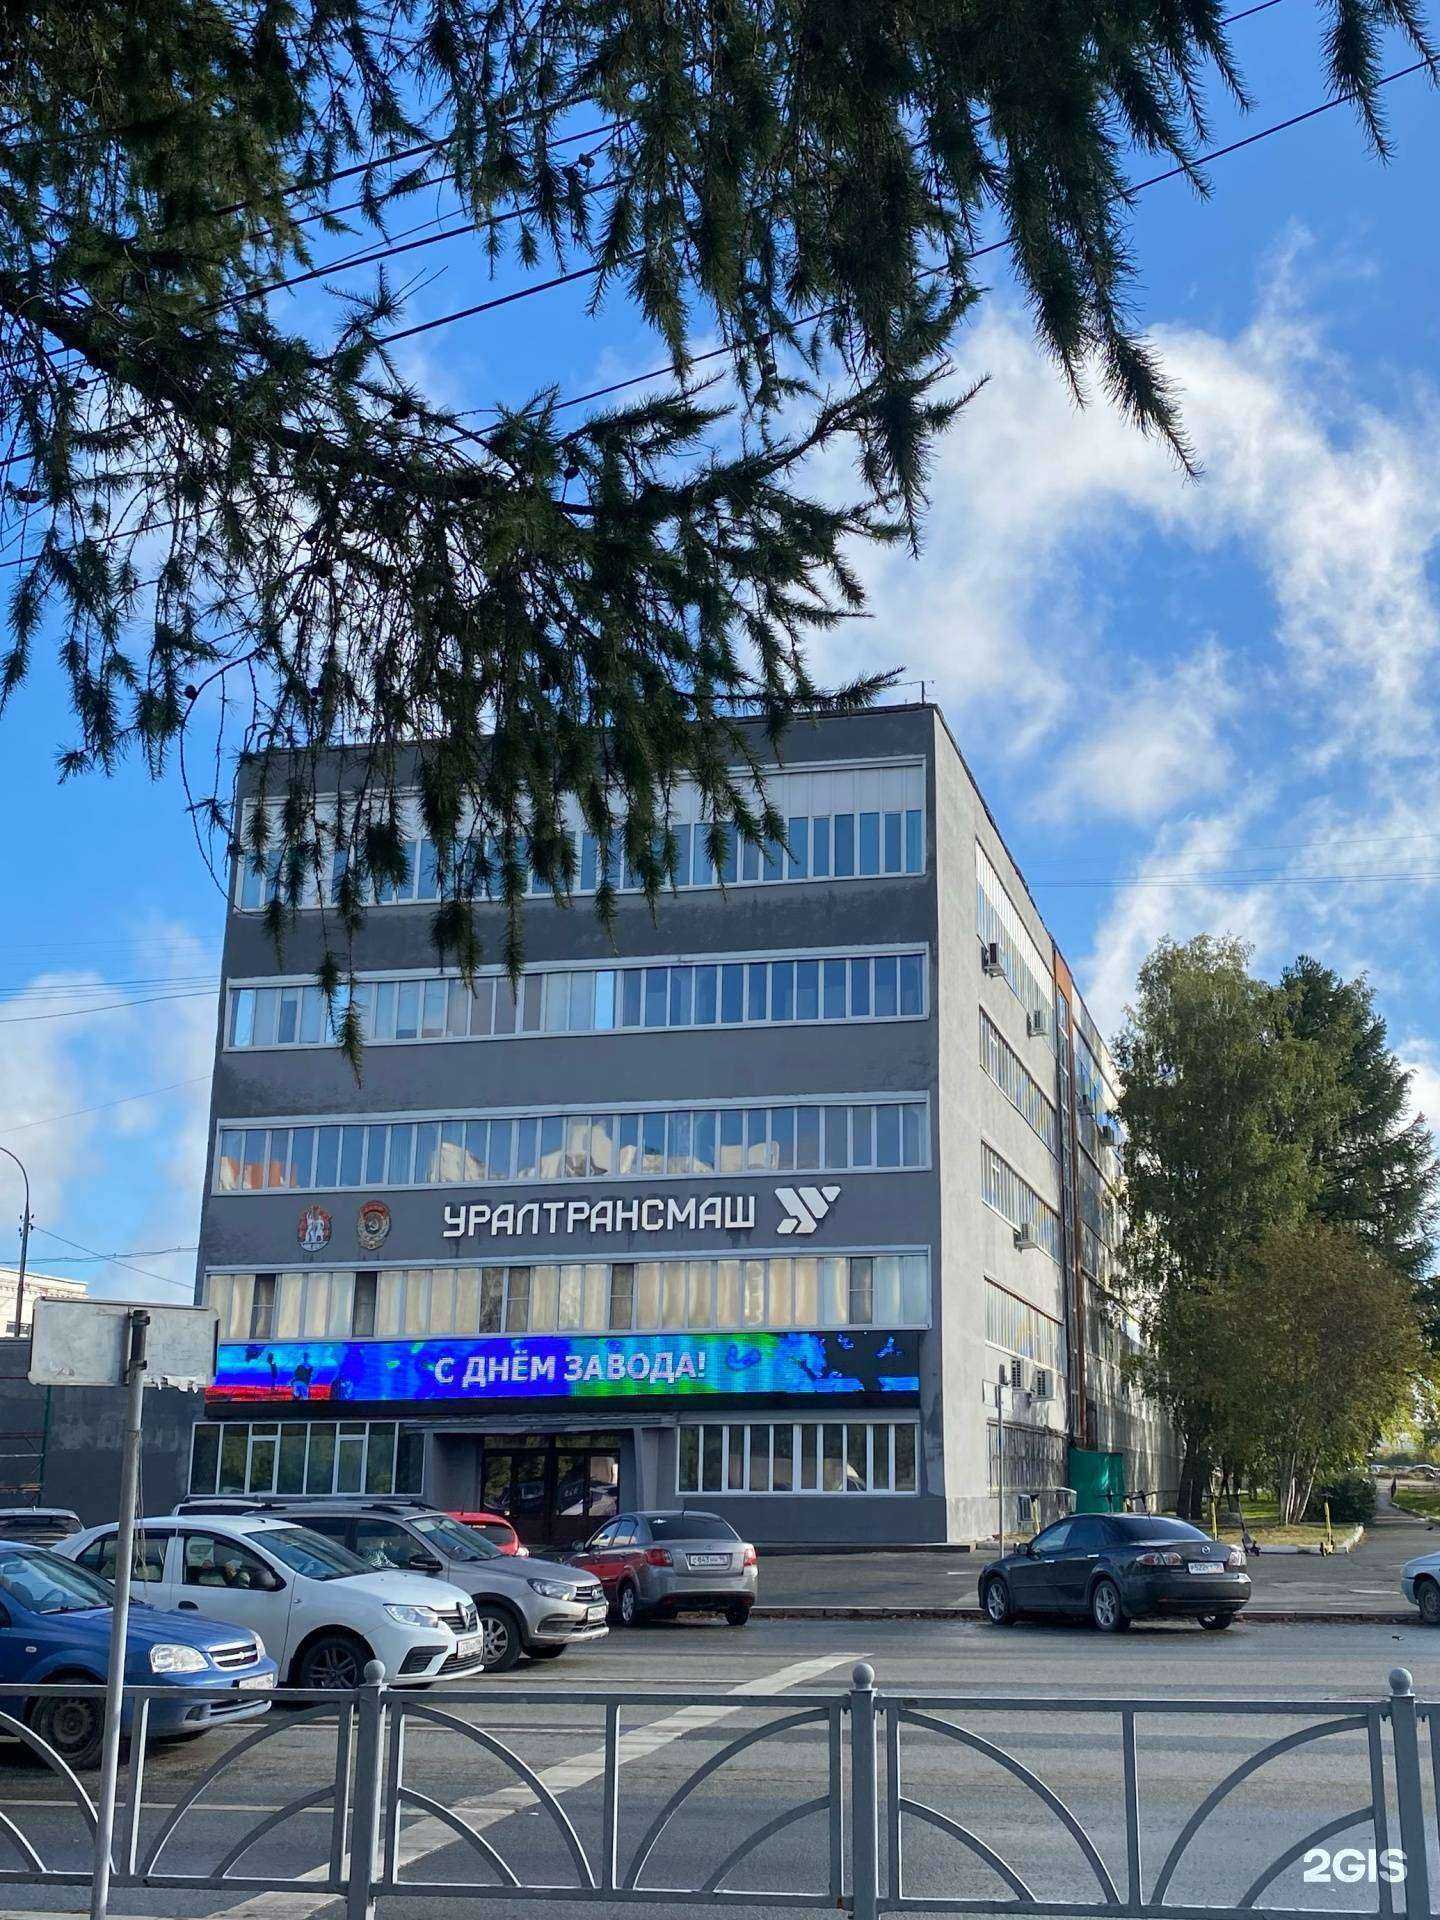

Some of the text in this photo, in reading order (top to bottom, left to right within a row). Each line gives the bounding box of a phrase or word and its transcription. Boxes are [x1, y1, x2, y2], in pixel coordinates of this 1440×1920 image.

[443, 1196, 755, 1237] УРАЛТРАНСМАШ
[434, 1349, 706, 1388] С ДНЁМ ЗАВОДА!
